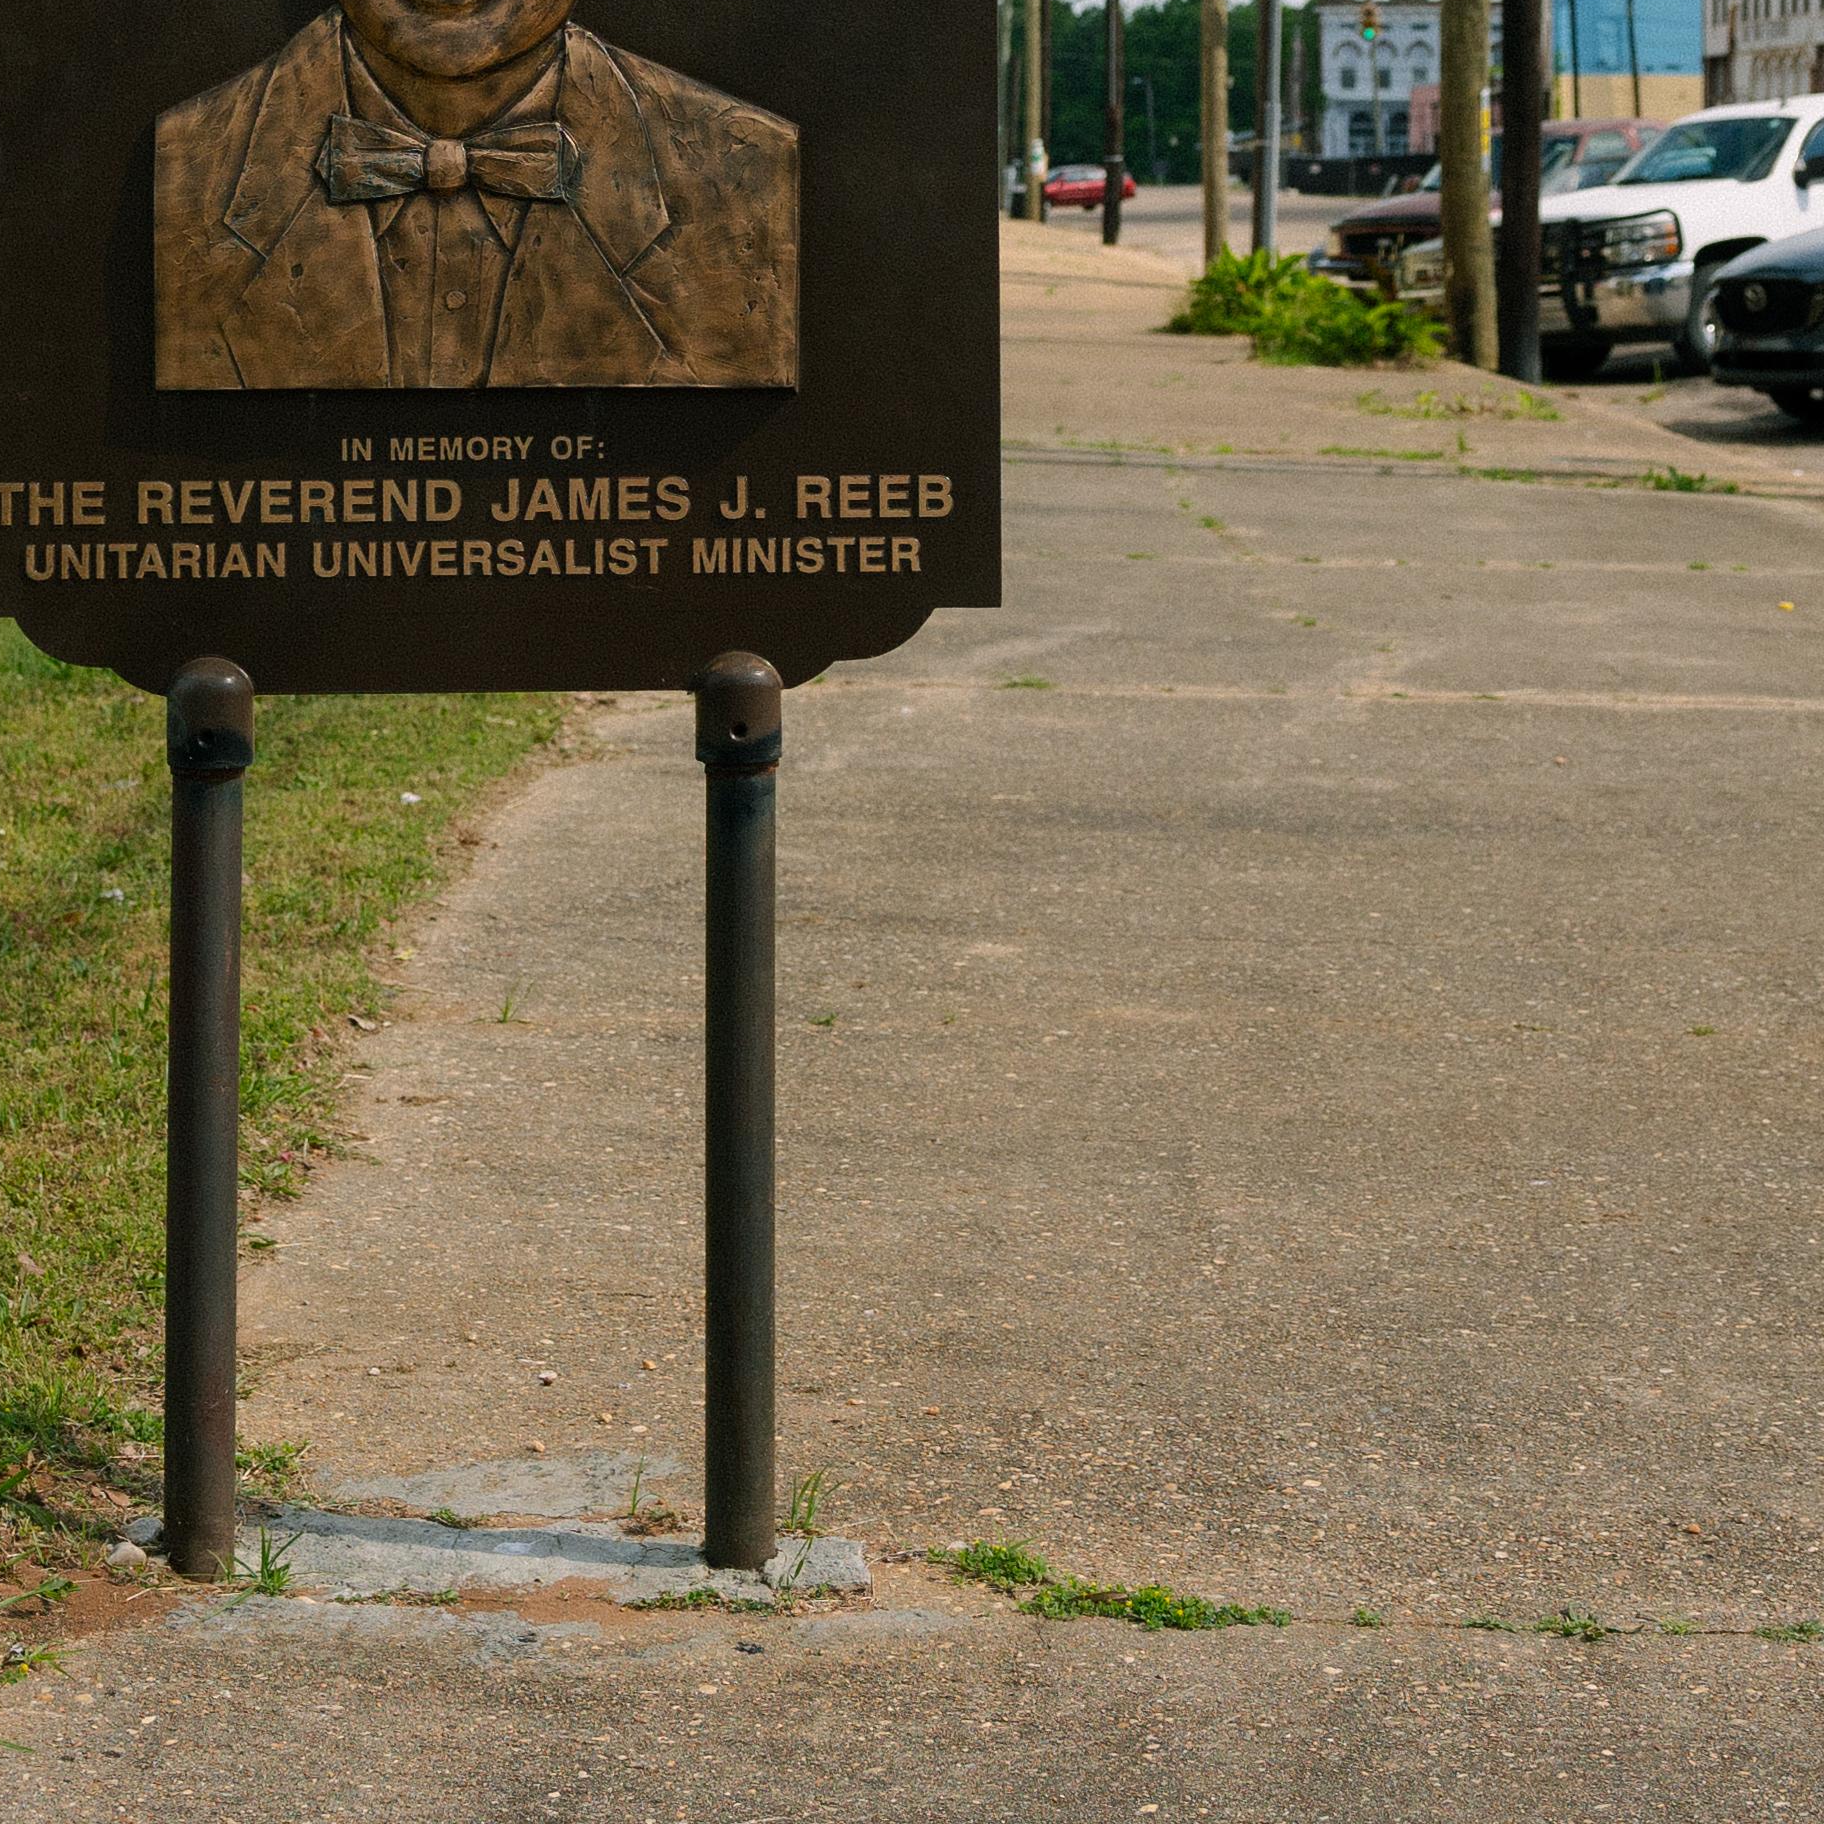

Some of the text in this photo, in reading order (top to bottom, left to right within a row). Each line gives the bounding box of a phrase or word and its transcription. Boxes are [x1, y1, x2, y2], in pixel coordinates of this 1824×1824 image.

[341, 436, 606, 463] IN MEMORY OF:
[137, 479, 464, 527] REVEREND
[490, 476, 693, 524] JAMES
[719, 475, 768, 522] J.
[796, 474, 956, 521] REEB
[25, 535, 924, 583] UNITARIAN UNIVERSALIST MINISTER
